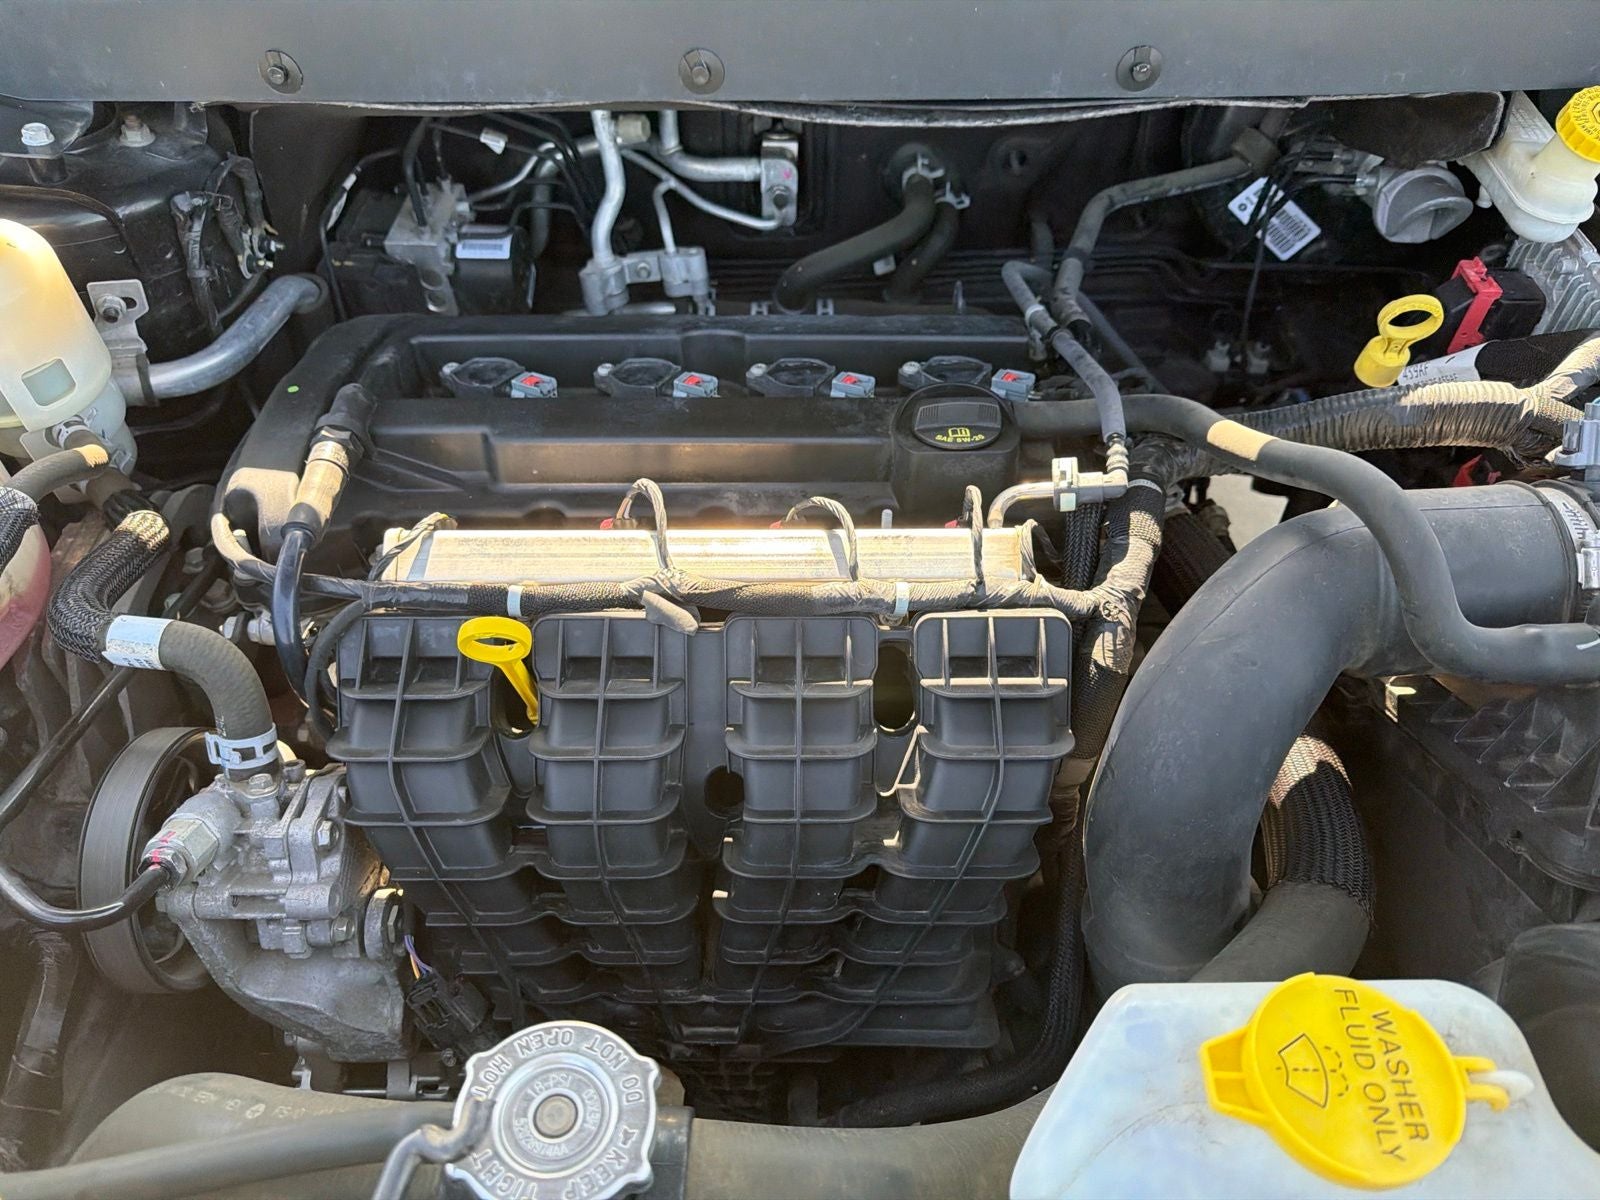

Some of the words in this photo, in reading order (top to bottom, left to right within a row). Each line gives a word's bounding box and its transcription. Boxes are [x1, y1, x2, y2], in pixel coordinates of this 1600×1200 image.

[934, 434, 953, 443] SAE
[956, 434, 985, 443] 5W-20
[513, 1027, 575, 1057] OPEN
[584, 1034, 629, 1070] NOT
[471, 1053, 513, 1102] HOT
[621, 1075, 645, 1105] DO
[1333, 989, 1376, 1070] FLUID
[1362, 1082, 1406, 1162] ONLY
[1371, 1010, 1429, 1141] WASHER
[471, 1148, 539, 1200] TIGHT
[563, 1147, 629, 1200] KEEP
